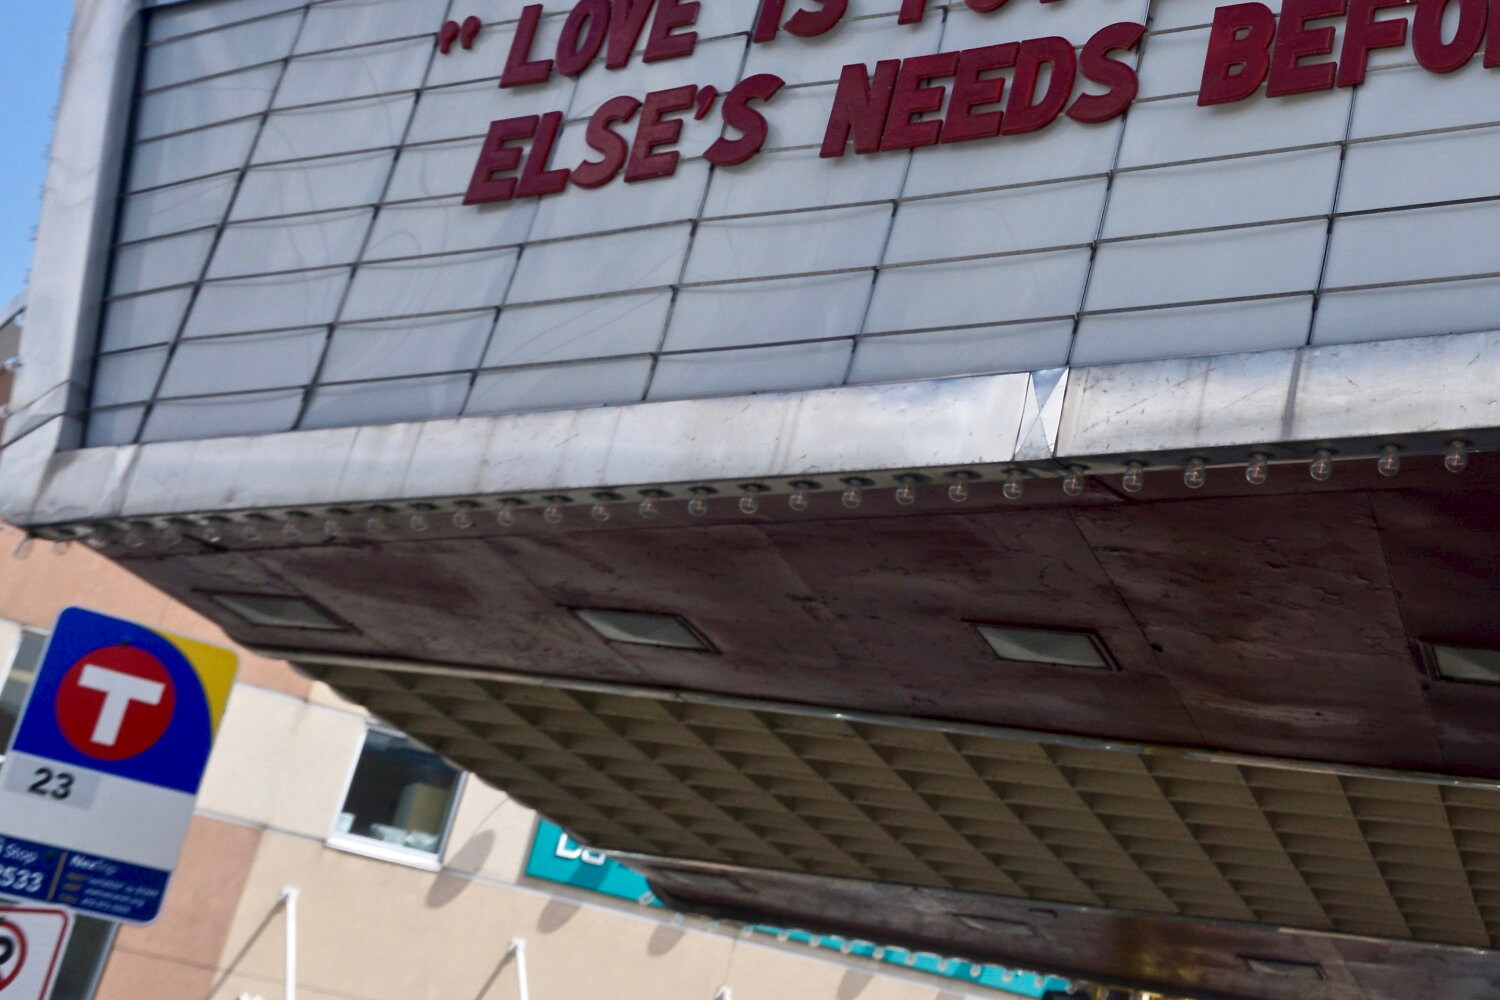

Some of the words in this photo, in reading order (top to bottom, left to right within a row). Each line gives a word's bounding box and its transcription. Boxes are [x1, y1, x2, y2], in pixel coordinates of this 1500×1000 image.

[461, 73, 786, 206] ELSE'S
[819, 21, 1149, 159] NEEDS
[77, 663, 166, 747] T
[28, 767, 75, 801] 23
[0, 863, 44, 893] 533
